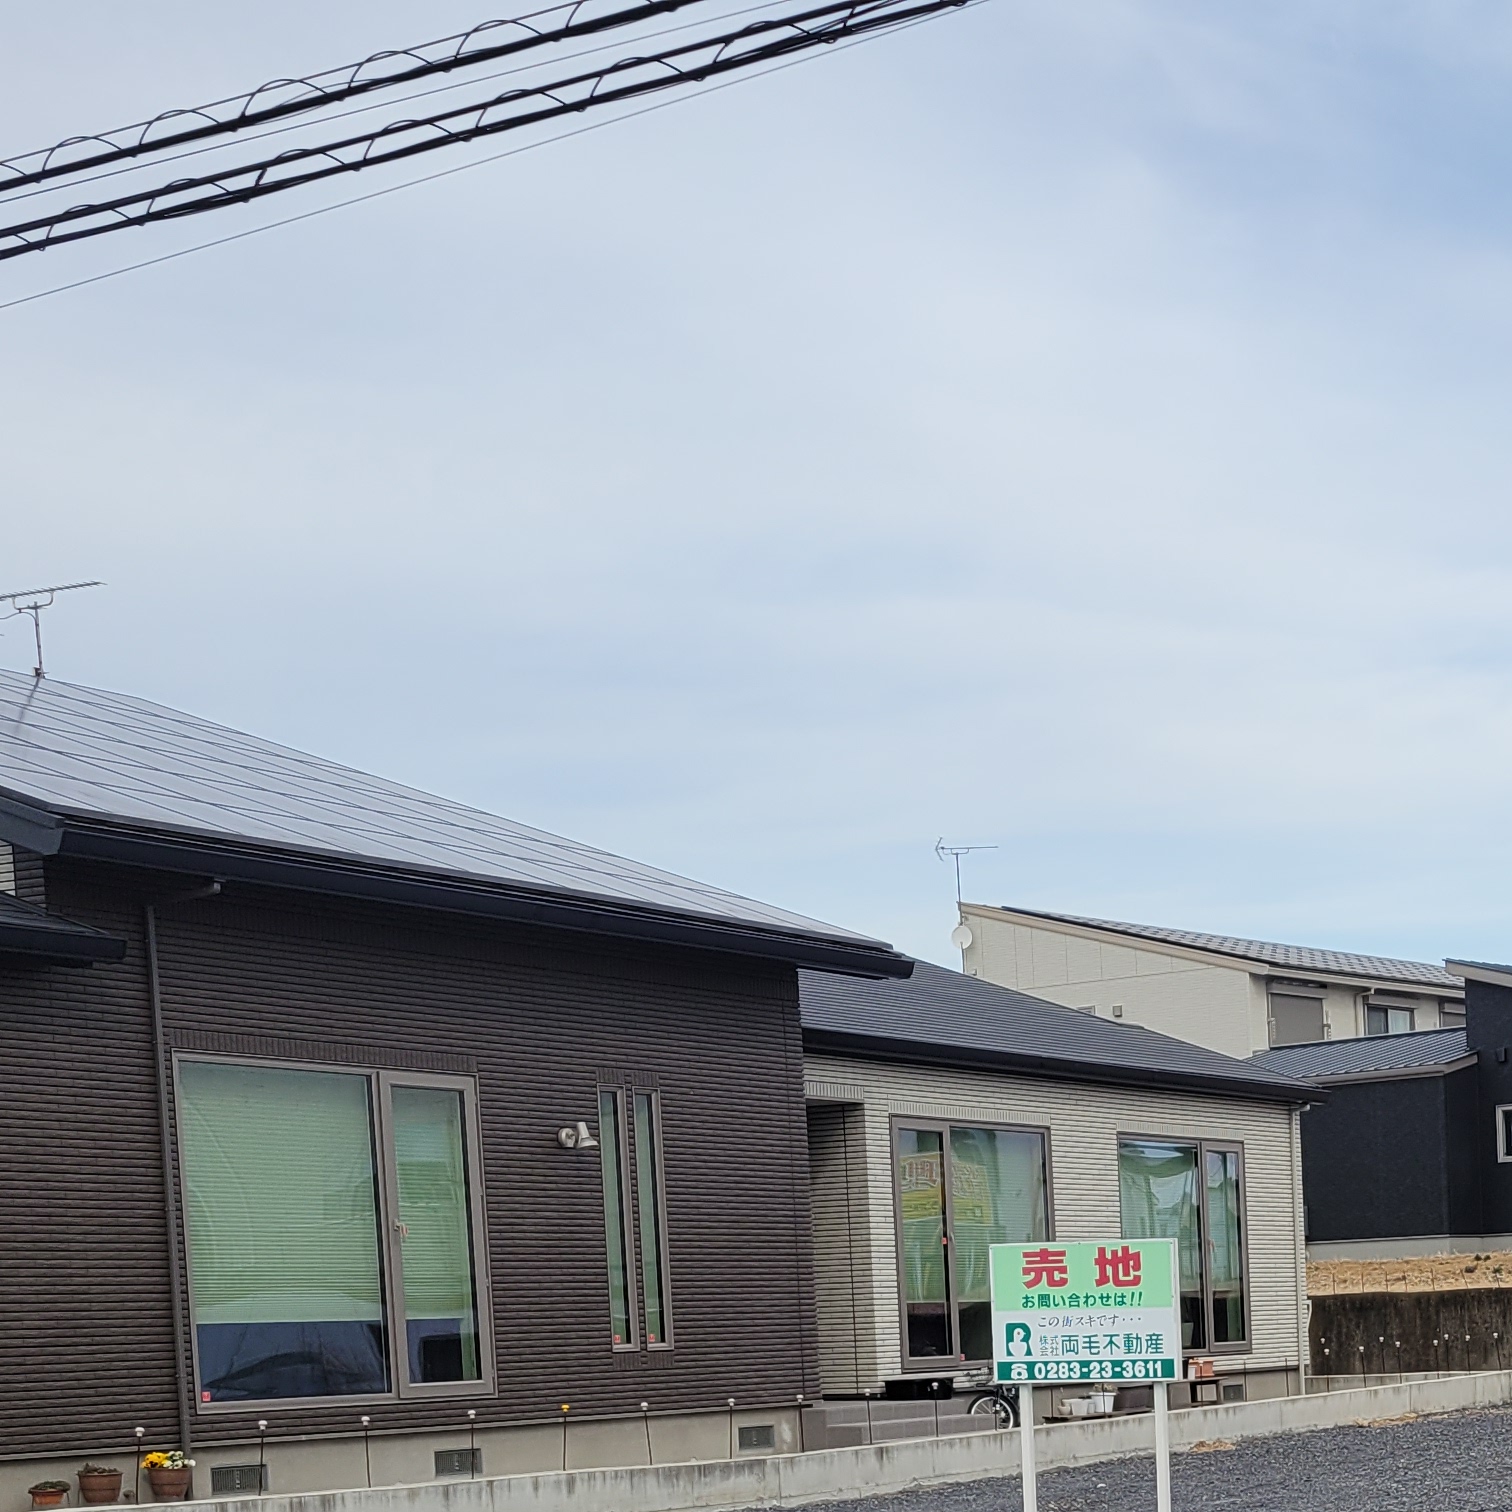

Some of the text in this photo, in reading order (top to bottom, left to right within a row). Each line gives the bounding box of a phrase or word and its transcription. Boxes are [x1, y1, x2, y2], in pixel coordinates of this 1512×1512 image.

[1061, 1332, 1164, 1356] 両毛不動産
[1033, 1360, 1162, 1379] 0283-23-3611
